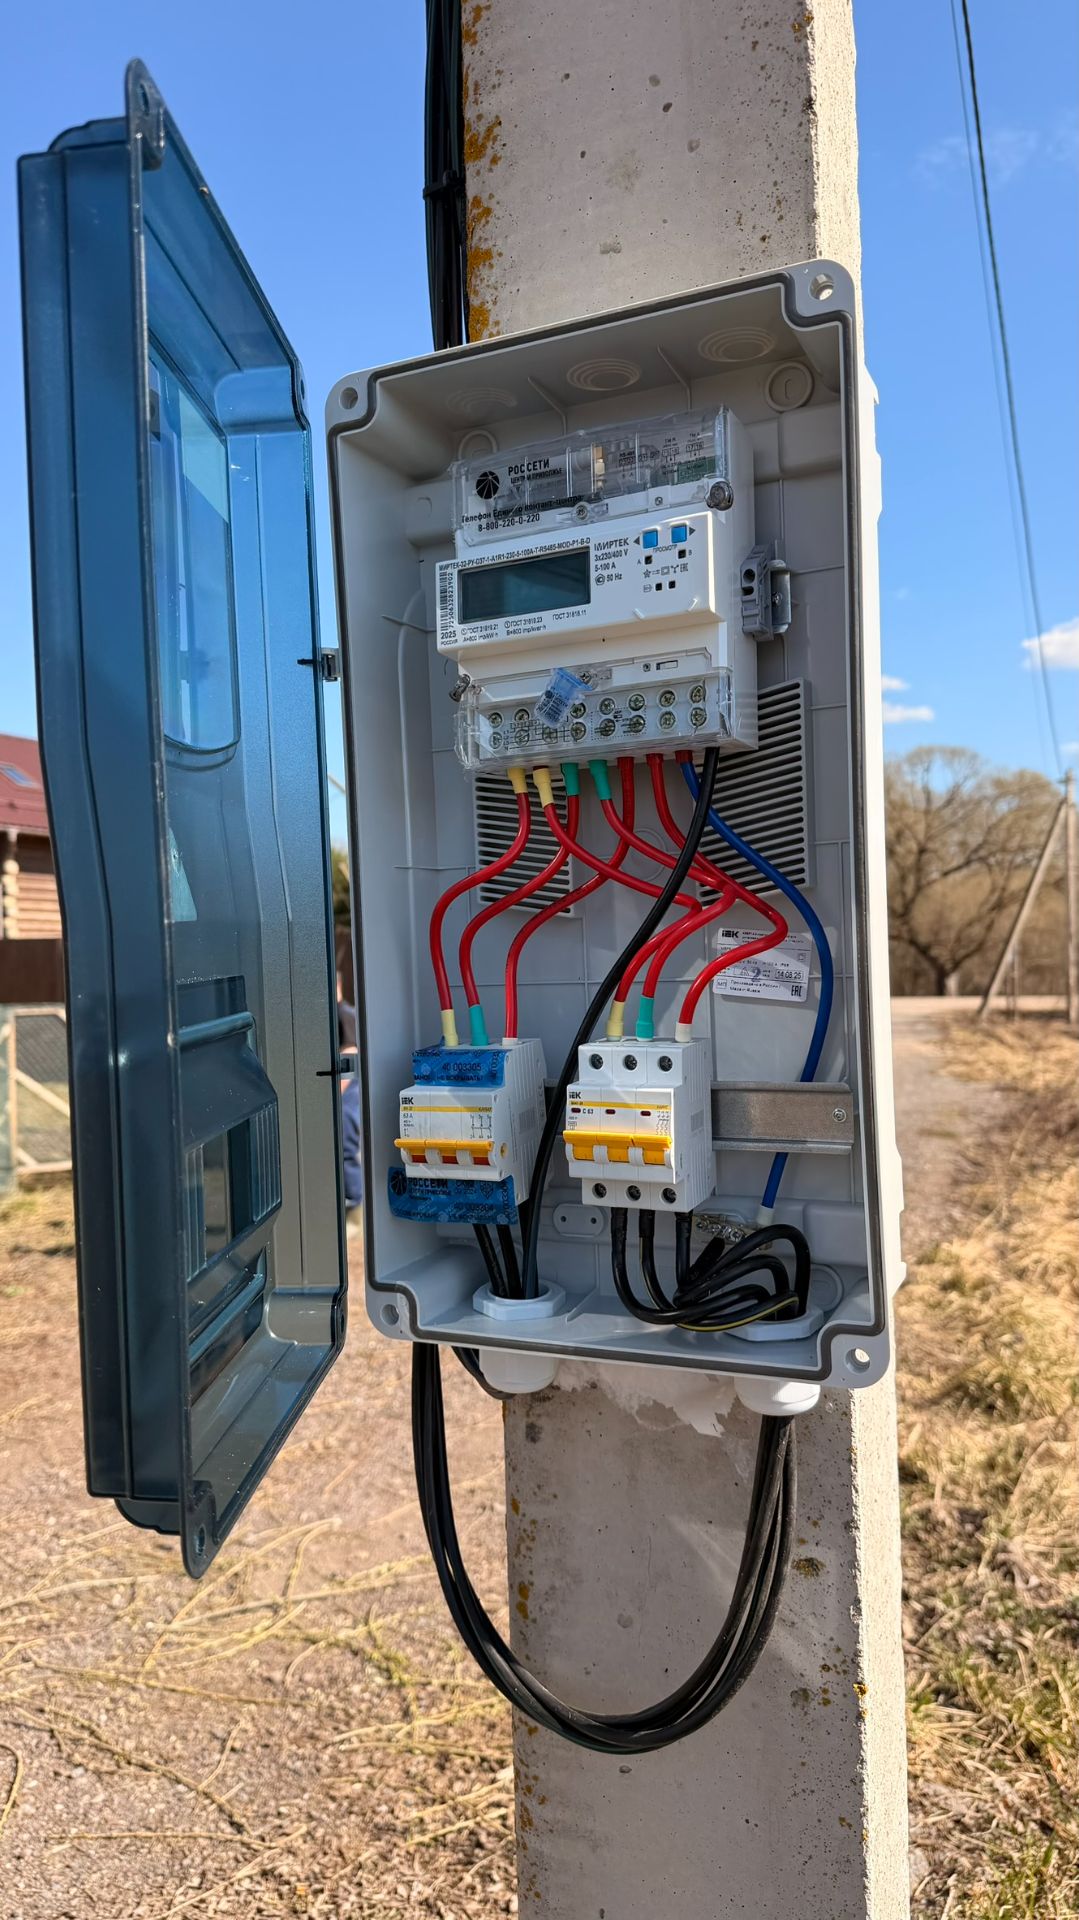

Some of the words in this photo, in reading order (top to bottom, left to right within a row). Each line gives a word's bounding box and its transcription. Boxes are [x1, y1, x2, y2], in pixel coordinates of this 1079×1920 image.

[508, 459, 550, 477] РОССЕТИ
[461, 510, 492, 524] Телефон
[478, 513, 541, 533] 8-800-220-0-220
[595, 563, 610, 573] 5-100
[611, 562, 617, 570] A
[606, 574, 614, 582] 50
[614, 572, 623, 581] Hz
[441, 630, 457, 640] 2025
